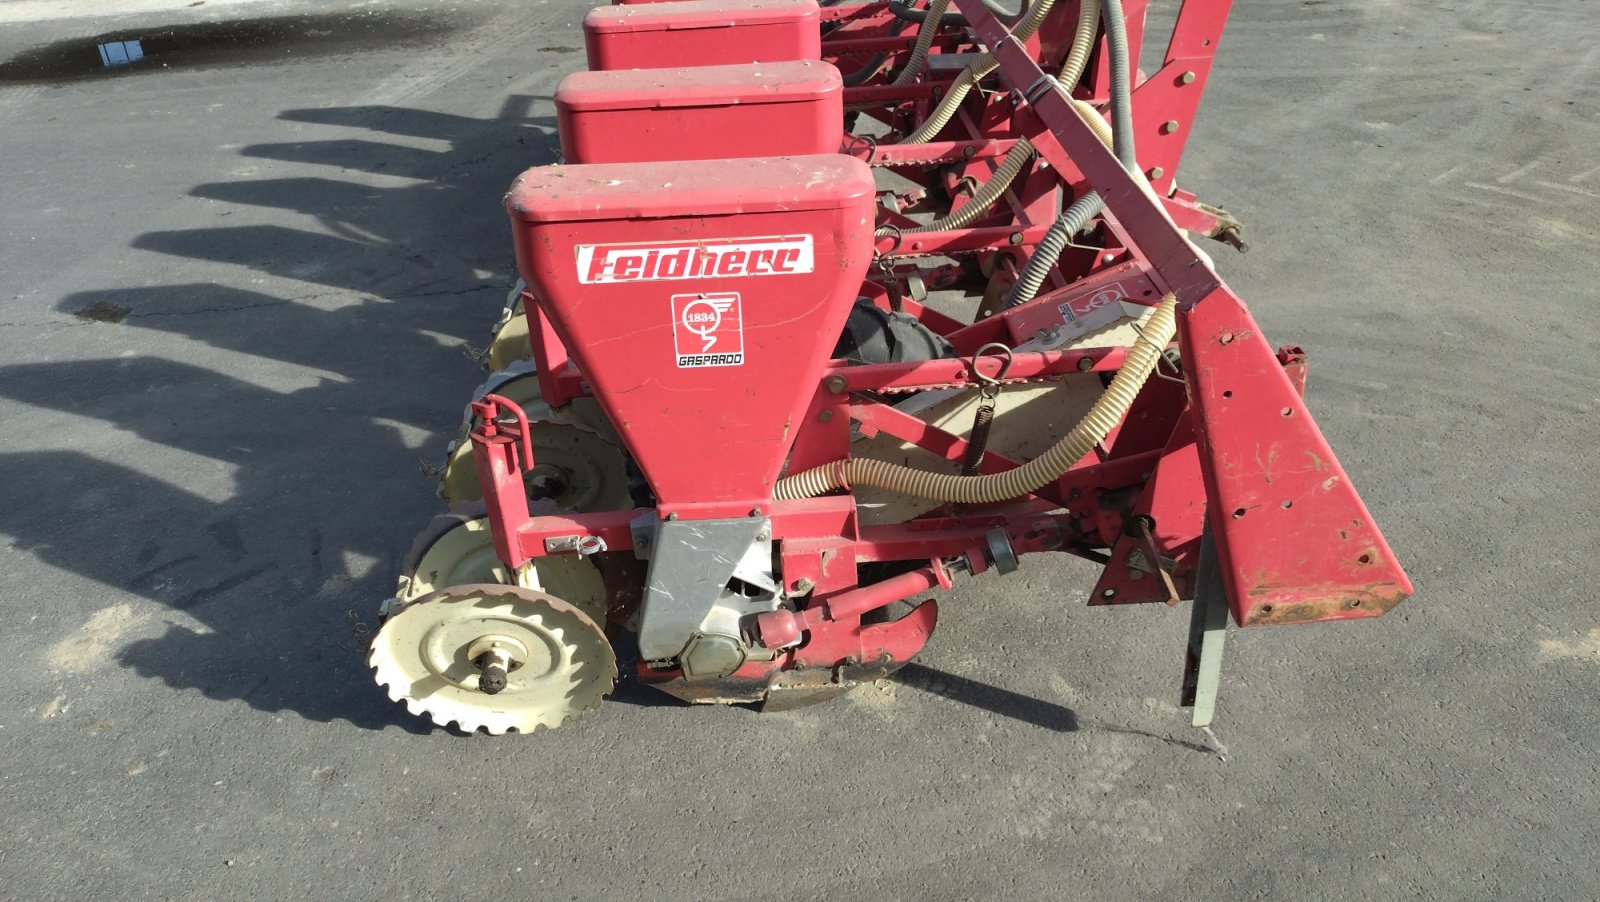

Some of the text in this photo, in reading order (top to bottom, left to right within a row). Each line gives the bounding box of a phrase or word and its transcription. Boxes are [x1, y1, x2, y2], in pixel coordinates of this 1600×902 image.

[587, 245, 801, 281] Feldherr
[688, 312, 717, 322] 1834
[679, 353, 742, 366] GASPARDO
